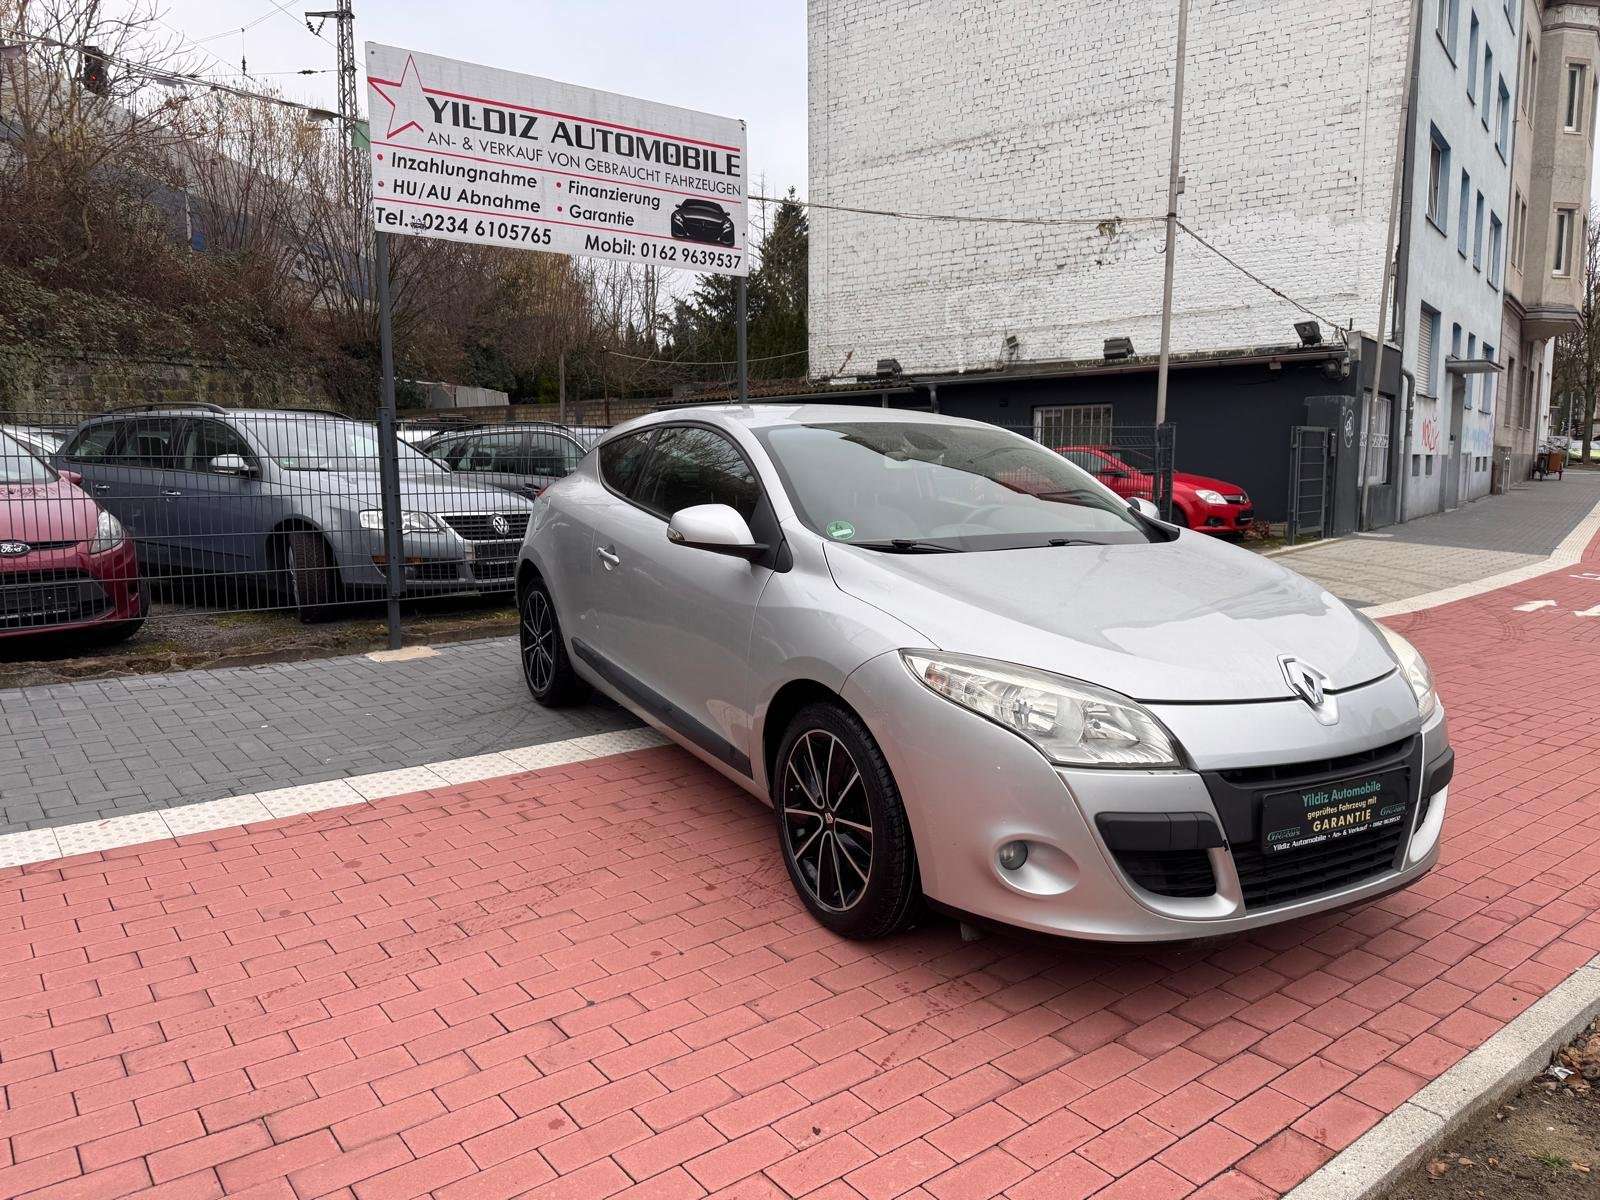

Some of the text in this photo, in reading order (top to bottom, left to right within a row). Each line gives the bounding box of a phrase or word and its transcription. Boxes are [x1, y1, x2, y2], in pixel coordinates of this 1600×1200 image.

[425, 96, 740, 177] YILDIZ AUTOMOBILE
[391, 152, 538, 188] Inzahlungnahme
[427, 131, 741, 196] AN- & VERKAUF VON GEBRAUCHT FAHRZEUGEN
[393, 179, 541, 213] HU/AU Abnahme
[568, 180, 661, 210] Finanzierung
[422, 212, 468, 234] 0234
[474, 220, 552, 245] 6105765
[569, 204, 635, 227] Garantie
[584, 234, 742, 270] Mobil: 0162 9639537
[0, 542, 27, 553] Ford
[1302, 781, 1381, 807] Yildiz Automobile
[1307, 806, 1338, 820] geprüftes
[1338, 800, 1367, 813] Fahrzeug
[1367, 795, 1377, 806] mit
[1312, 809, 1371, 832] GARANTIE
[1273, 841, 1291, 851] Yildiz
[1291, 834, 1327, 848] Automobile
[1348, 823, 1368, 834] Verkauf
